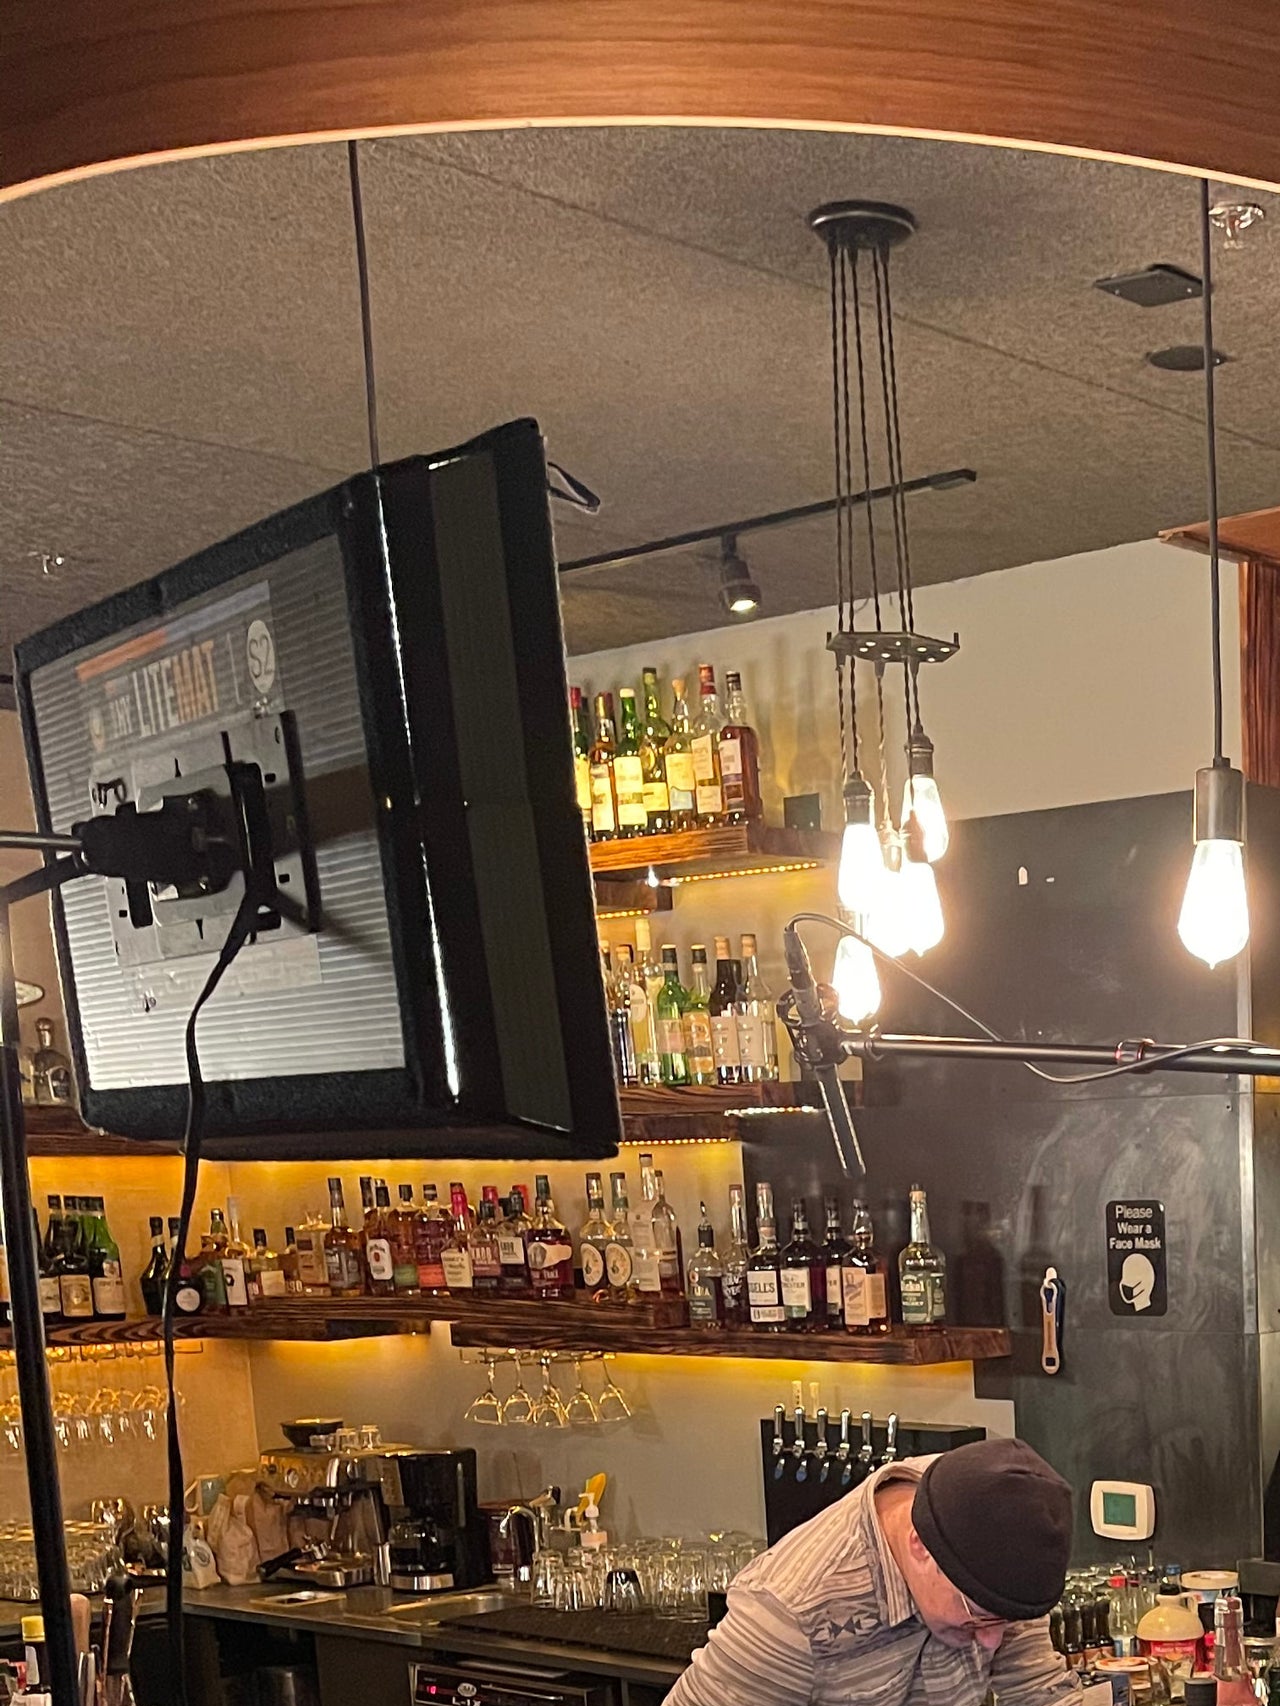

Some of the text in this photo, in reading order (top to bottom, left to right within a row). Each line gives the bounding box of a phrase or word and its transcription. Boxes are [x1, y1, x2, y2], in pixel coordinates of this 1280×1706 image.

[132, 640, 219, 739] LITEMAT
[249, 634, 275, 679] S2
[1115, 1205, 1153, 1219] Please
[1117, 1222, 1153, 1234] Wear a
[1109, 1237, 1161, 1249] Face Mask
